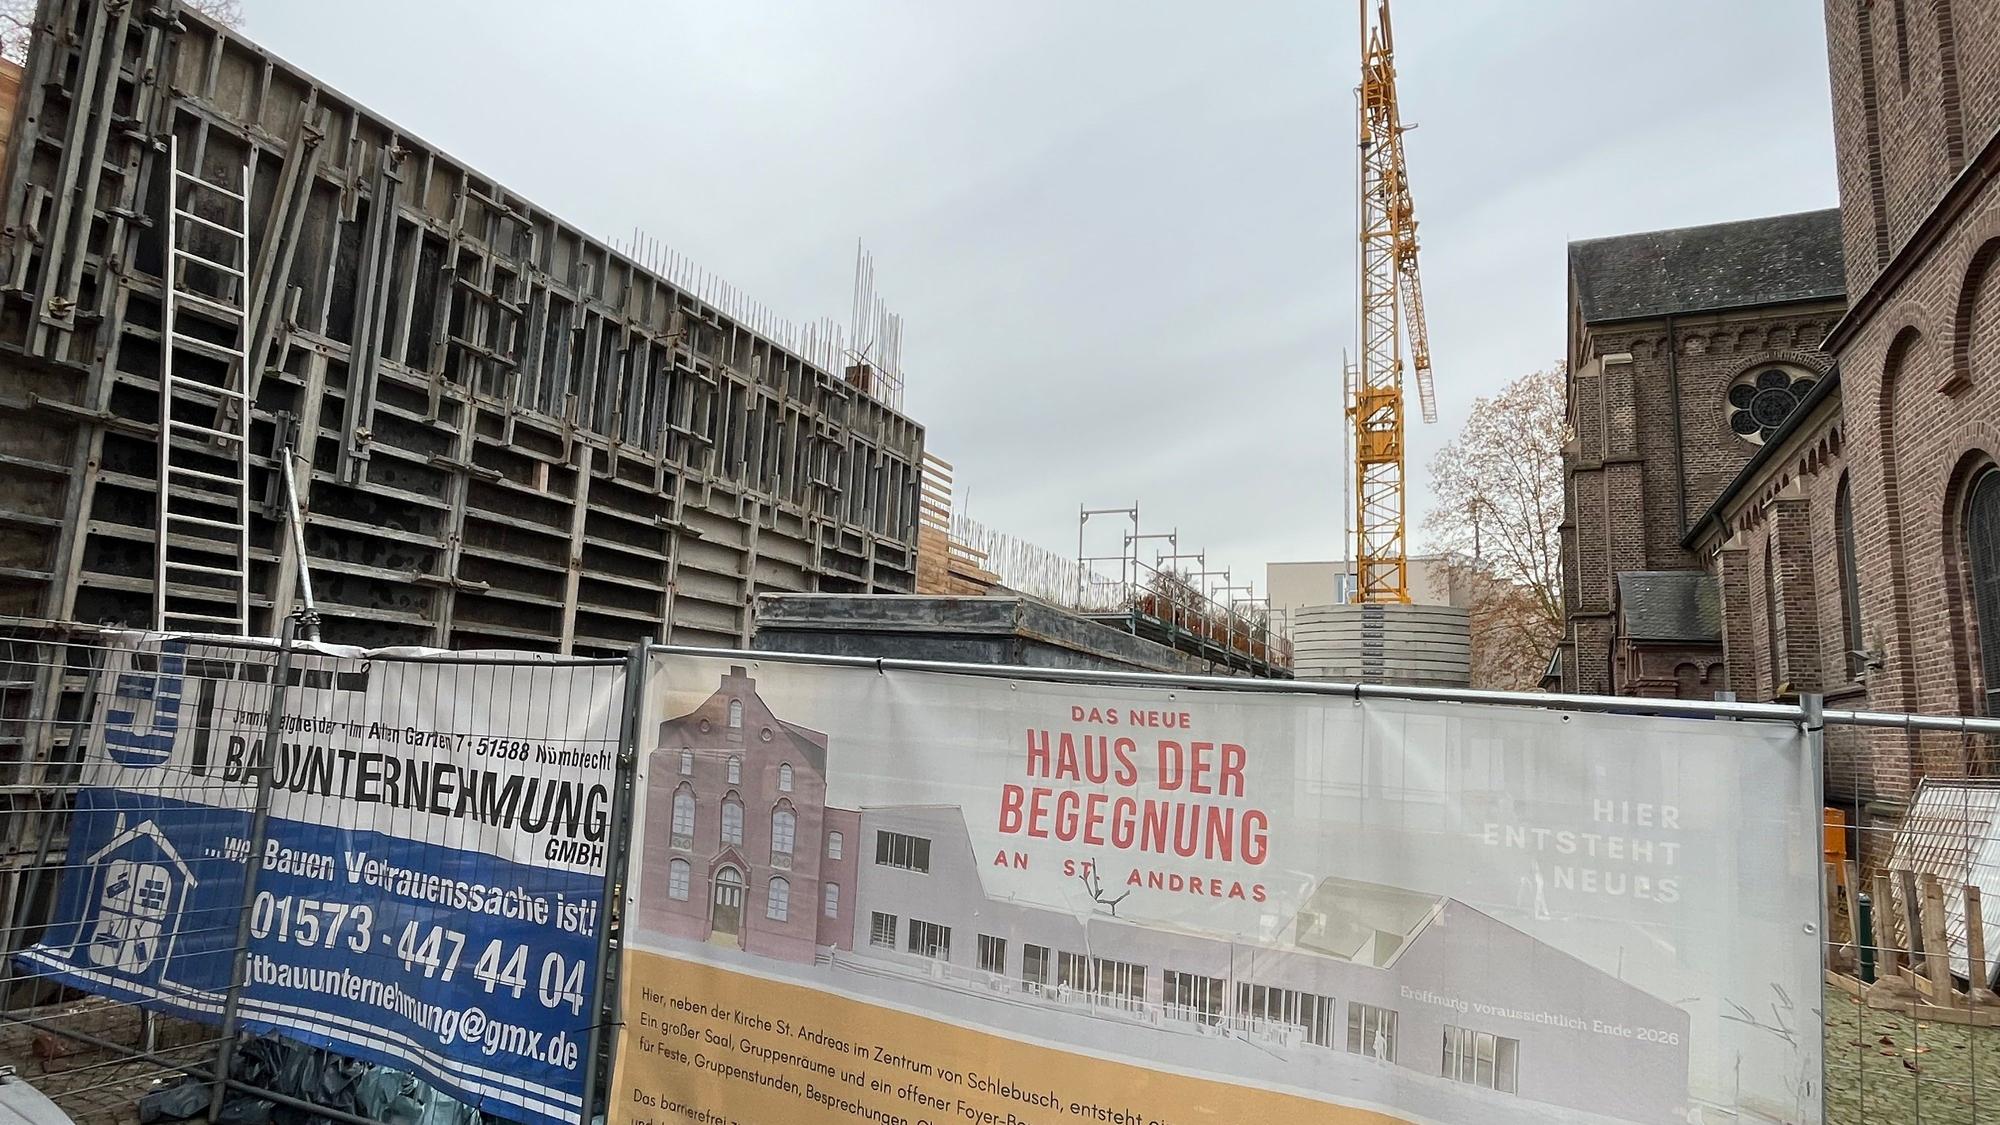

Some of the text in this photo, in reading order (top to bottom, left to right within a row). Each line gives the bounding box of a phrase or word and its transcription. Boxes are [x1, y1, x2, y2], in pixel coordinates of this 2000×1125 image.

[277, 713, 337, 735] elgheider
[348, 719, 362, 739] Im
[405, 726, 452, 752] Garten
[456, 733, 465, 753] 7
[476, 737, 530, 762] 51588
[535, 744, 612, 771] Nümbrecht
[1071, 705, 1191, 729] DAS NEUE
[222, 735, 608, 843] BAUUNTERNEHMUNG
[1026, 728, 1247, 797] HAUS DER
[998, 784, 1269, 866] BEGEGNUNG
[1483, 822, 1681, 865] ENTSTEHT
[1593, 798, 1680, 830] HIER
[544, 837, 604, 868] GMBH
[993, 850, 1029, 870] AN
[1127, 869, 1268, 903] ANDREAS
[262, 838, 335, 882] Bauen
[344, 851, 549, 926] Vertrauenssache
[556, 892, 598, 937] ist!
[1553, 865, 1681, 904] NEUES
[250, 890, 373, 954] 01573
[397, 920, 466, 982] 447
[474, 938, 529, 999] 44
[538, 952, 586, 1016] 04
[243, 952, 578, 1071] jtbauunternehmung@gmx.de
[1400, 985, 1680, 1046] Eröffnung voraussichtlich Ende 2026
[639, 1035, 655, 1053] für
[658, 1042, 691, 1066] Feste,
[694, 1053, 802, 1098] Gruppenstunden,
[640, 1011, 658, 1029] Ein
[661, 1019, 701, 1040] großer
[704, 1028, 735, 1051] Saal,
[739, 1038, 836, 1078] Gruppenräume
[841, 1070, 865, 1087] und
[870, 1078, 892, 1095] ein
[897, 1084, 951, 1112] offener
[642, 987, 1143, 1125] Hier, neben der Kirche St. Andreas im Zentrum von Schlebusch, entsteht
[633, 1088, 656, 1107] Das
